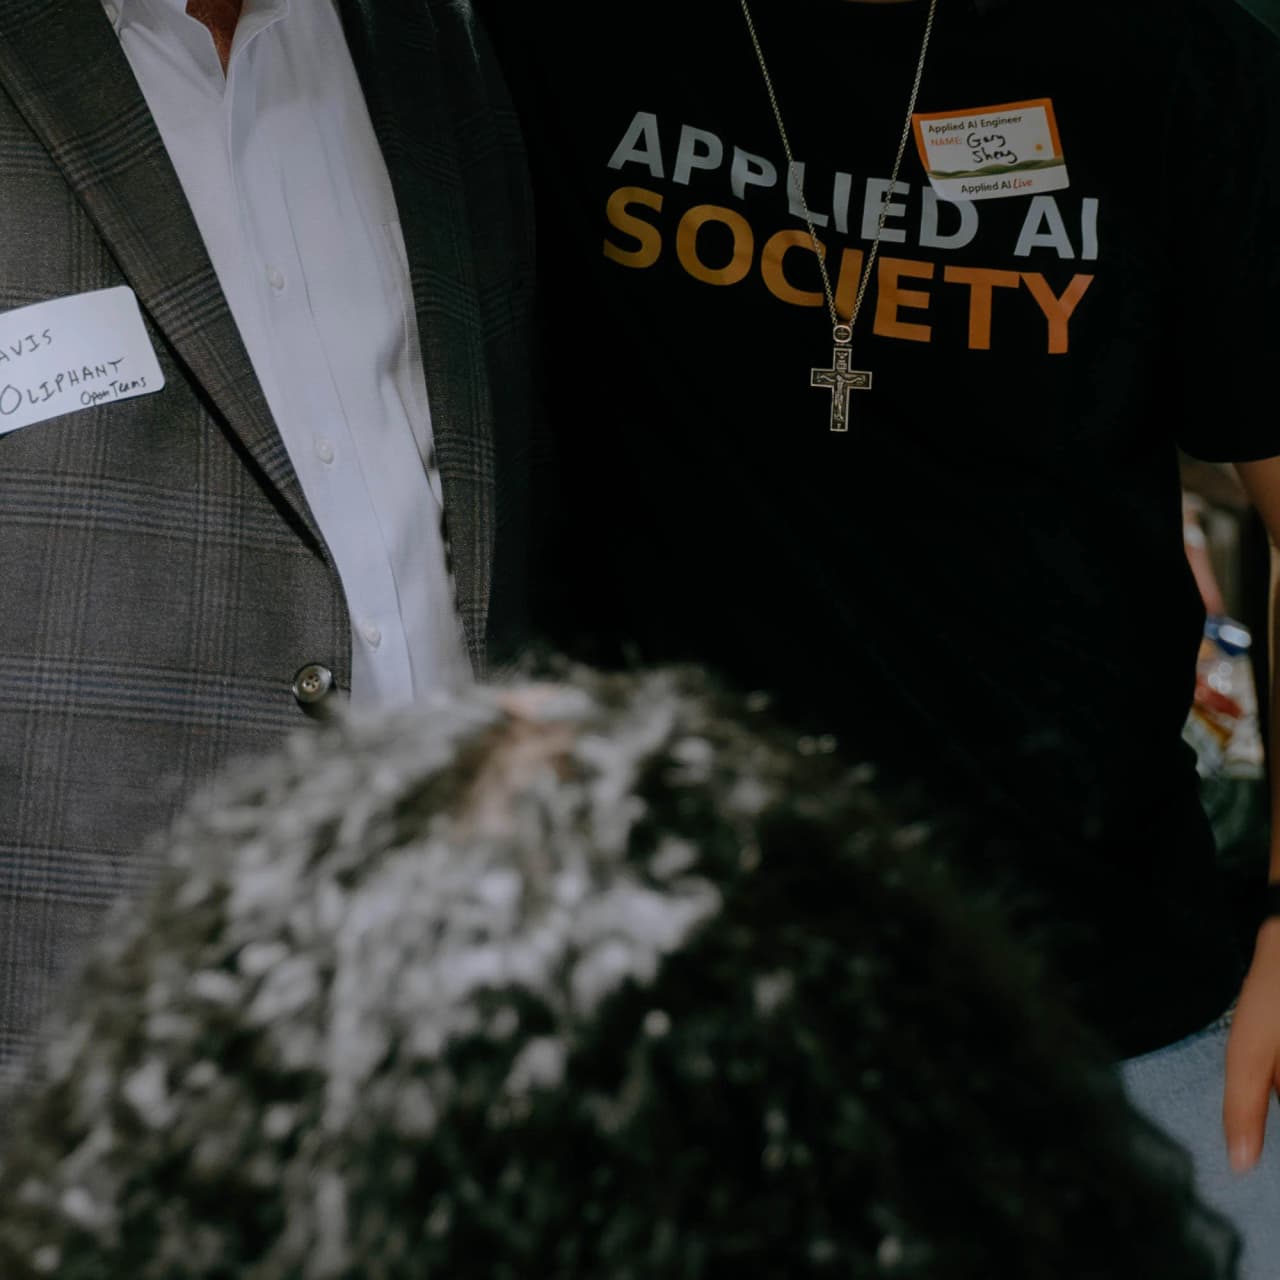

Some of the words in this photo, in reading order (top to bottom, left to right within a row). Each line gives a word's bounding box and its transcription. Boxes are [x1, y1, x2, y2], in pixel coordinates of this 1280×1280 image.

[928, 121, 965, 135] Applied
[967, 120, 978, 130] AI
[980, 116, 1023, 129] Engineer
[967, 132, 1006, 149] Gary
[607, 111, 979, 250] APPLIED
[1013, 194, 1099, 261] AI
[961, 180, 999, 194] Applied
[1001, 179, 1012, 190] AI
[1013, 178, 1033, 190] Live
[603, 185, 1095, 354] SOCIETY
